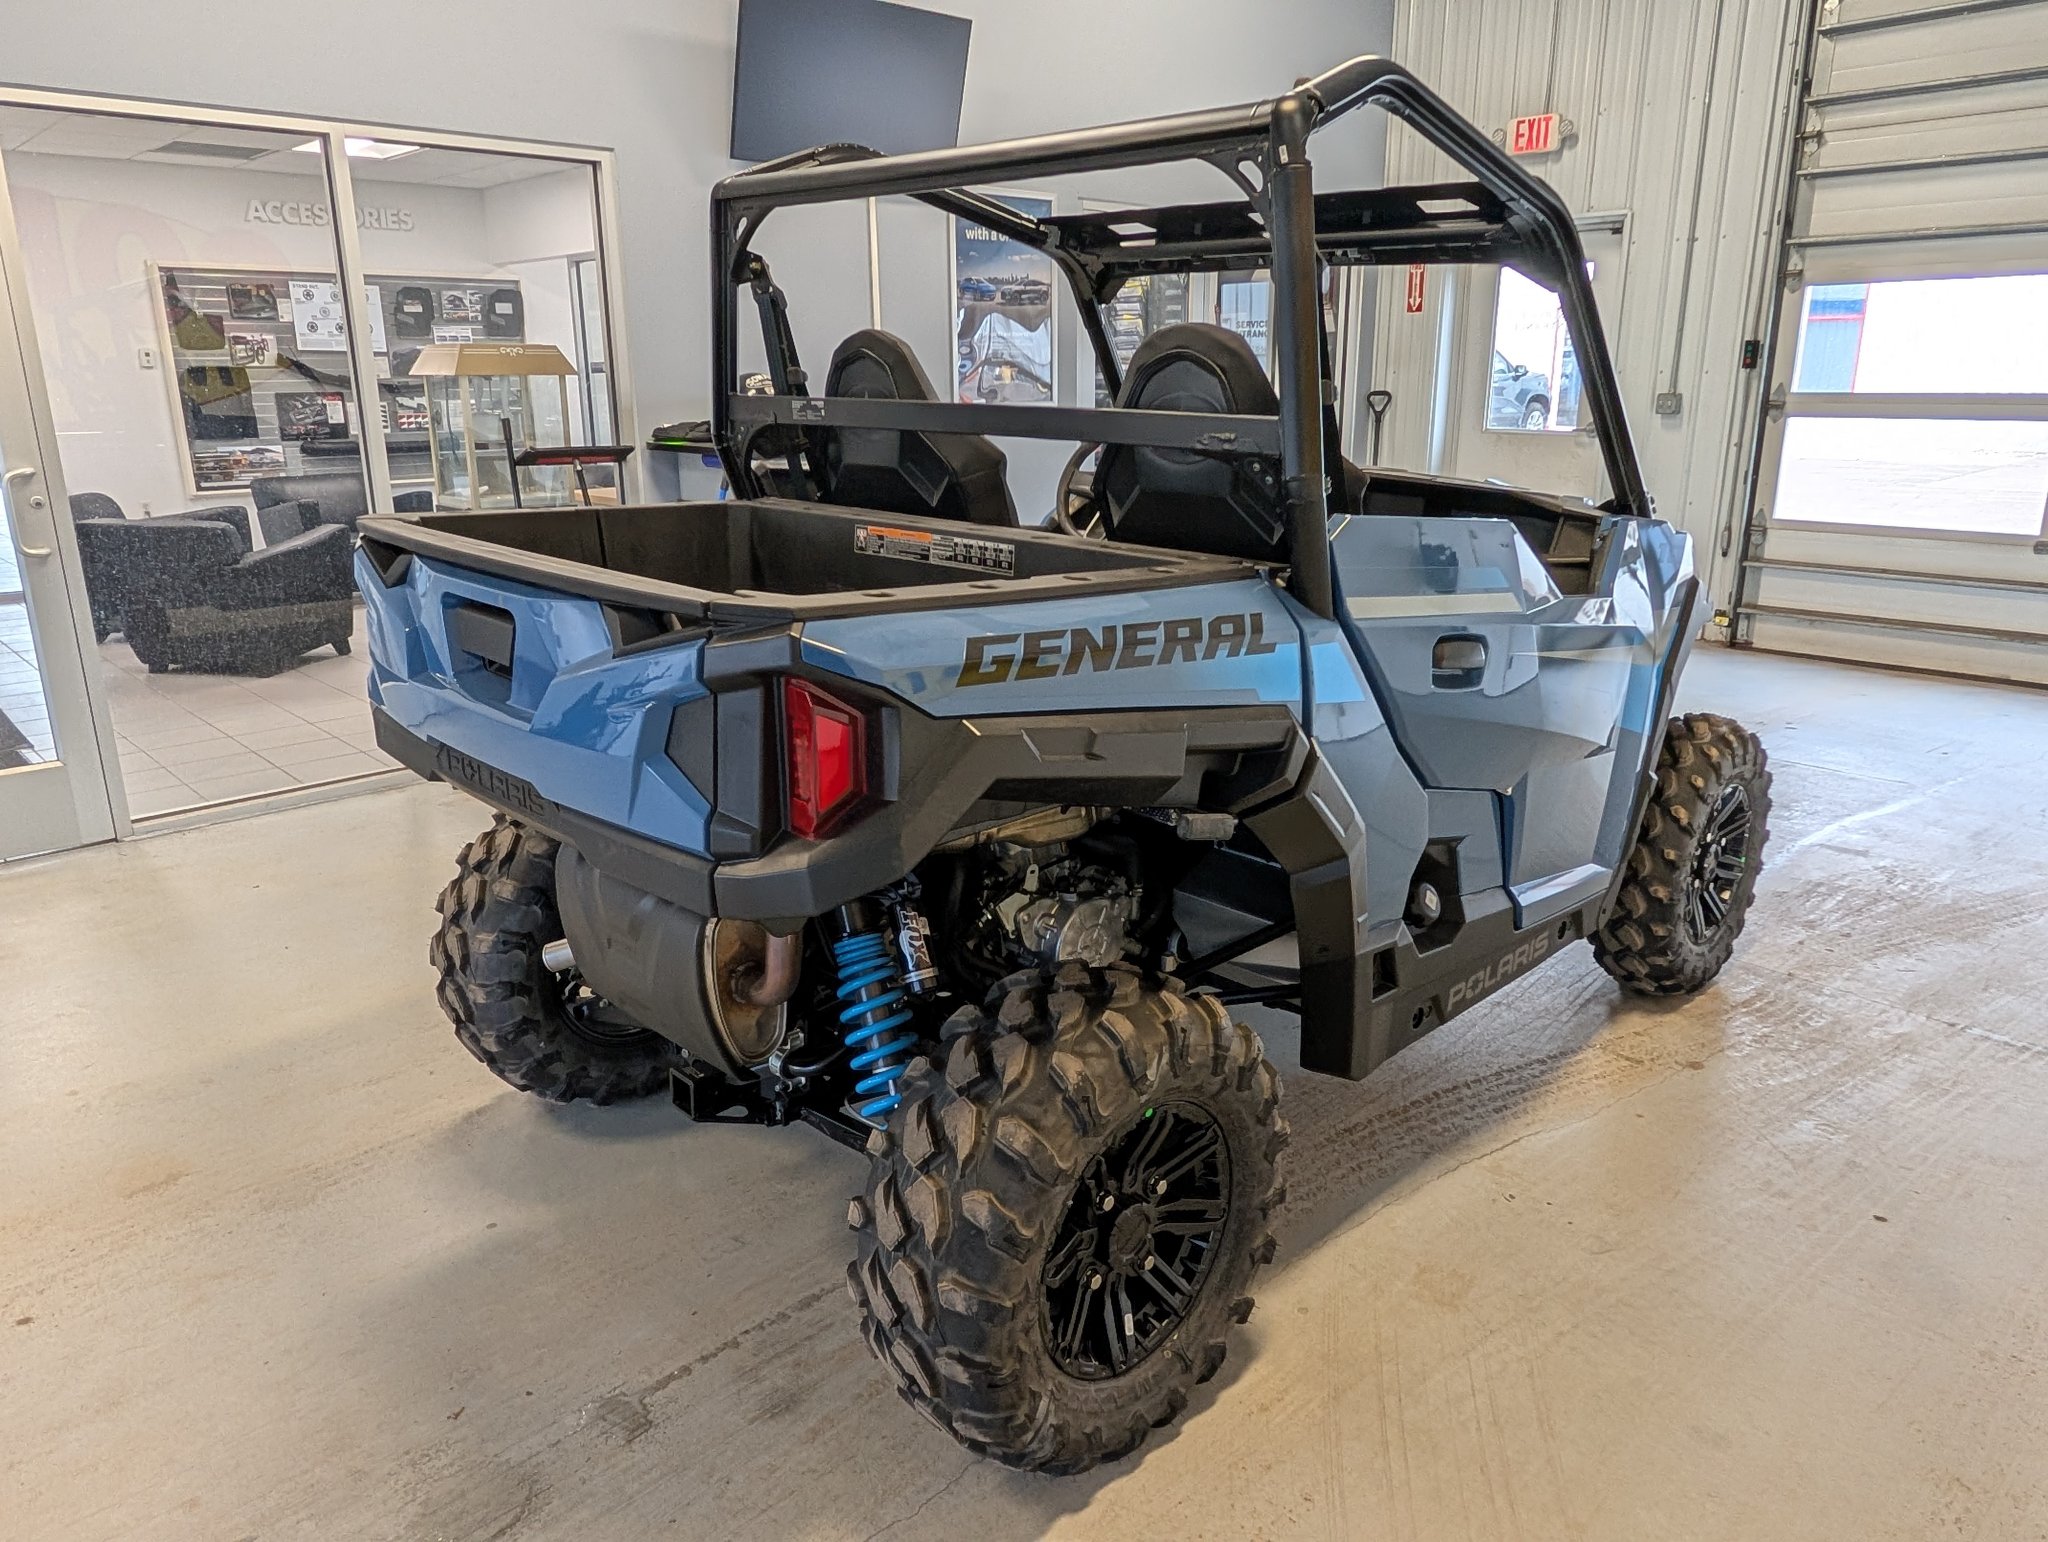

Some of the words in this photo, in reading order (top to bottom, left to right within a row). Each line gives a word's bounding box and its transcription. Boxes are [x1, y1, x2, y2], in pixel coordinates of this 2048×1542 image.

[1513, 115, 1553, 153] EXIT
[245, 199, 414, 231] ACCESRIES
[965, 226, 990, 241] with
[956, 612, 1277, 688] GENERAL
[446, 746, 545, 817] POLARIS
[900, 910, 932, 969] FOX
[1447, 930, 1550, 1013] POLARIS
